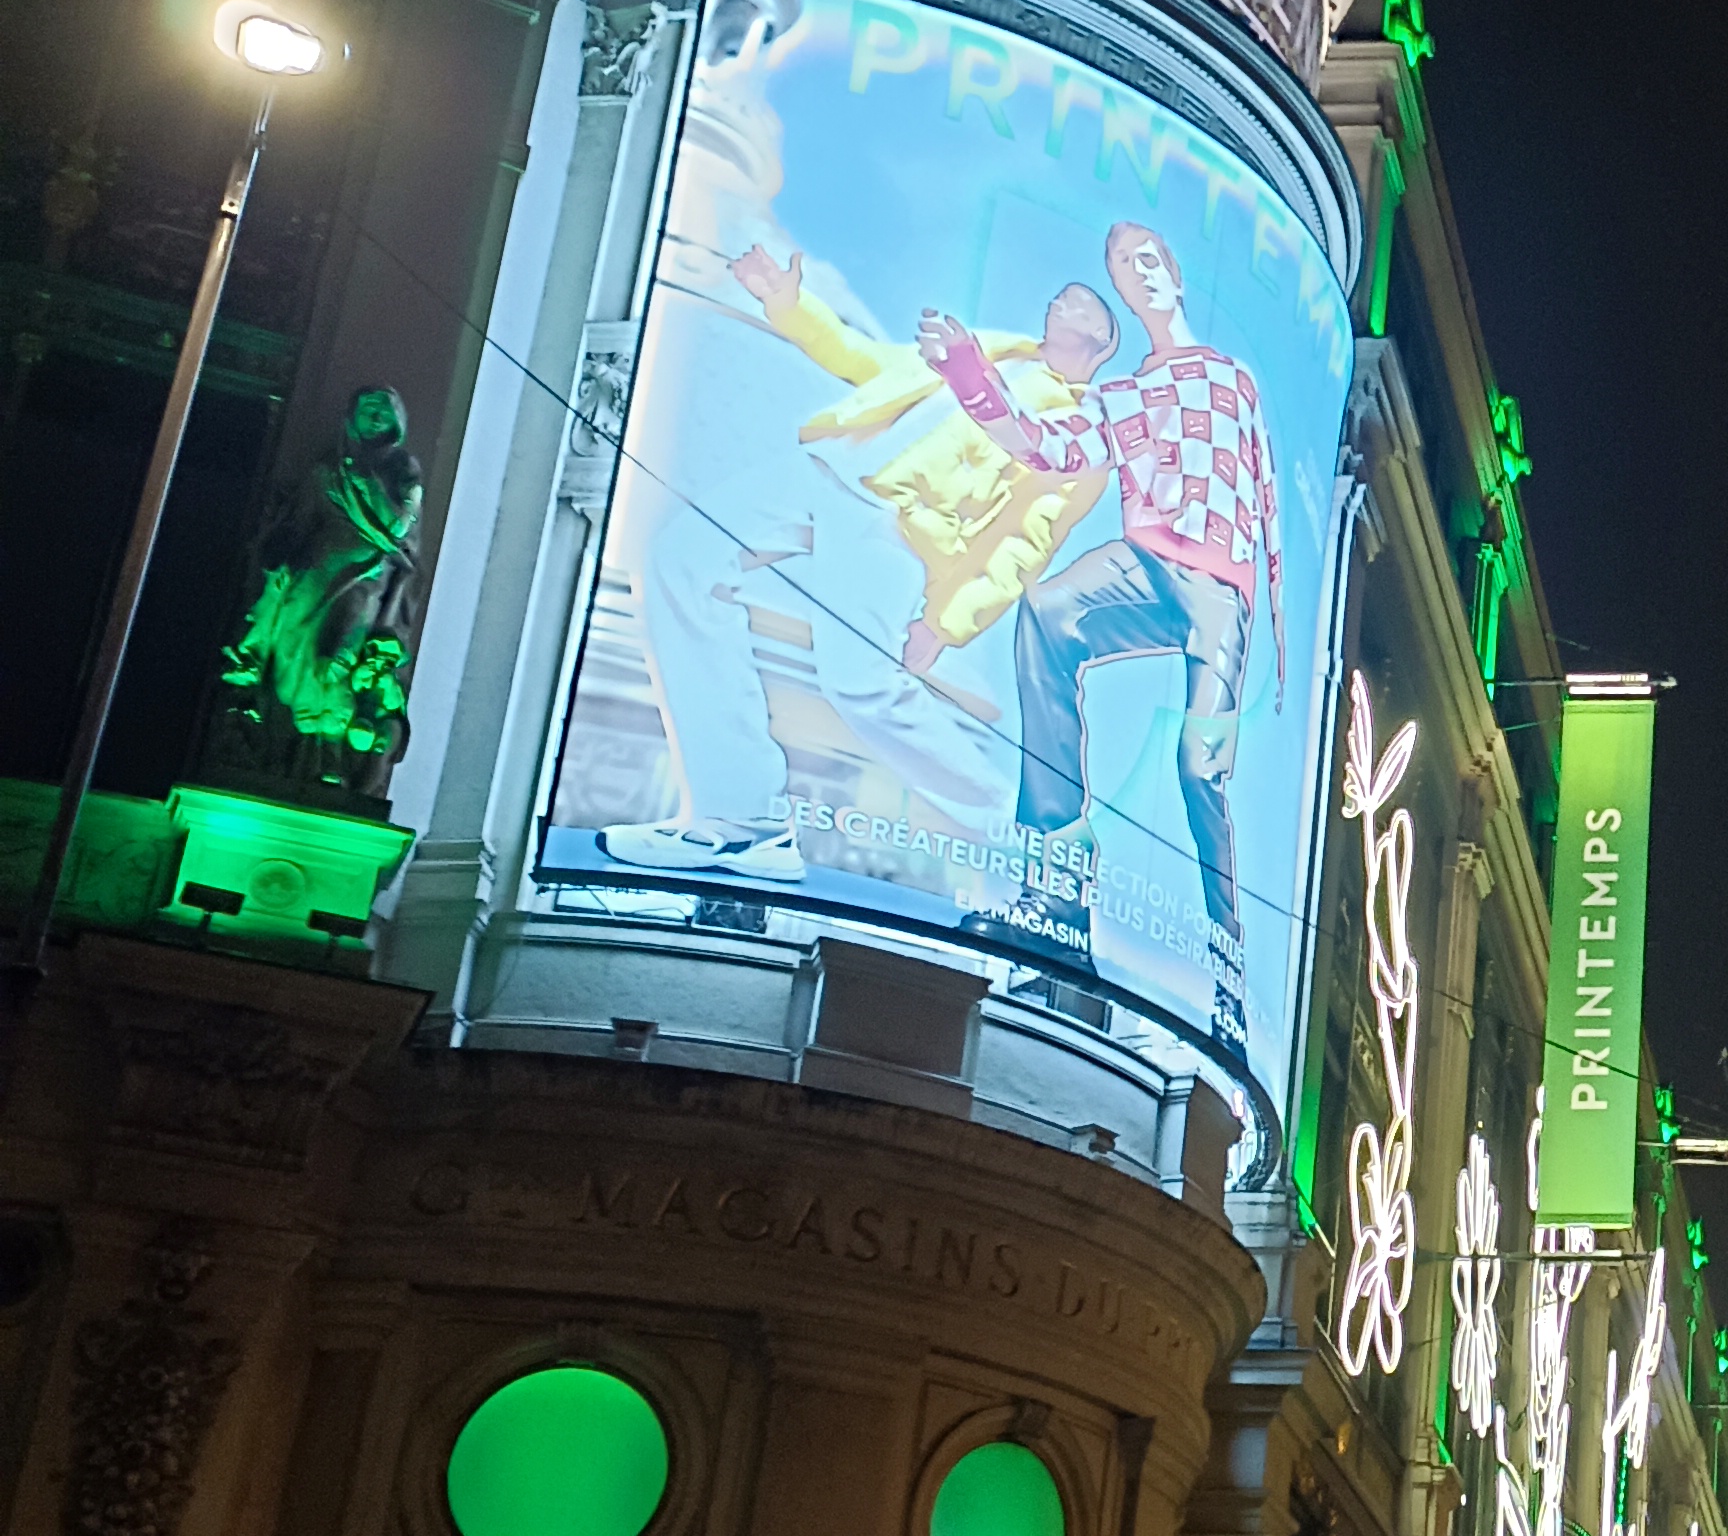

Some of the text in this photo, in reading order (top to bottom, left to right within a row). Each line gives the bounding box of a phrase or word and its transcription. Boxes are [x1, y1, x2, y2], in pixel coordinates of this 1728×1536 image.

[767, 795, 834, 831] DES
[844, 812, 1025, 883] CRÉATEURS
[1034, 866, 1079, 902] LES
[1086, 883, 1145, 930] PLUS
[986, 819, 1044, 858] UNE
[1050, 839, 1179, 917] SÉLECTION
[988, 902, 1089, 951] MAGASIN
[1571, 806, 1622, 1111] PRINTEMPS
